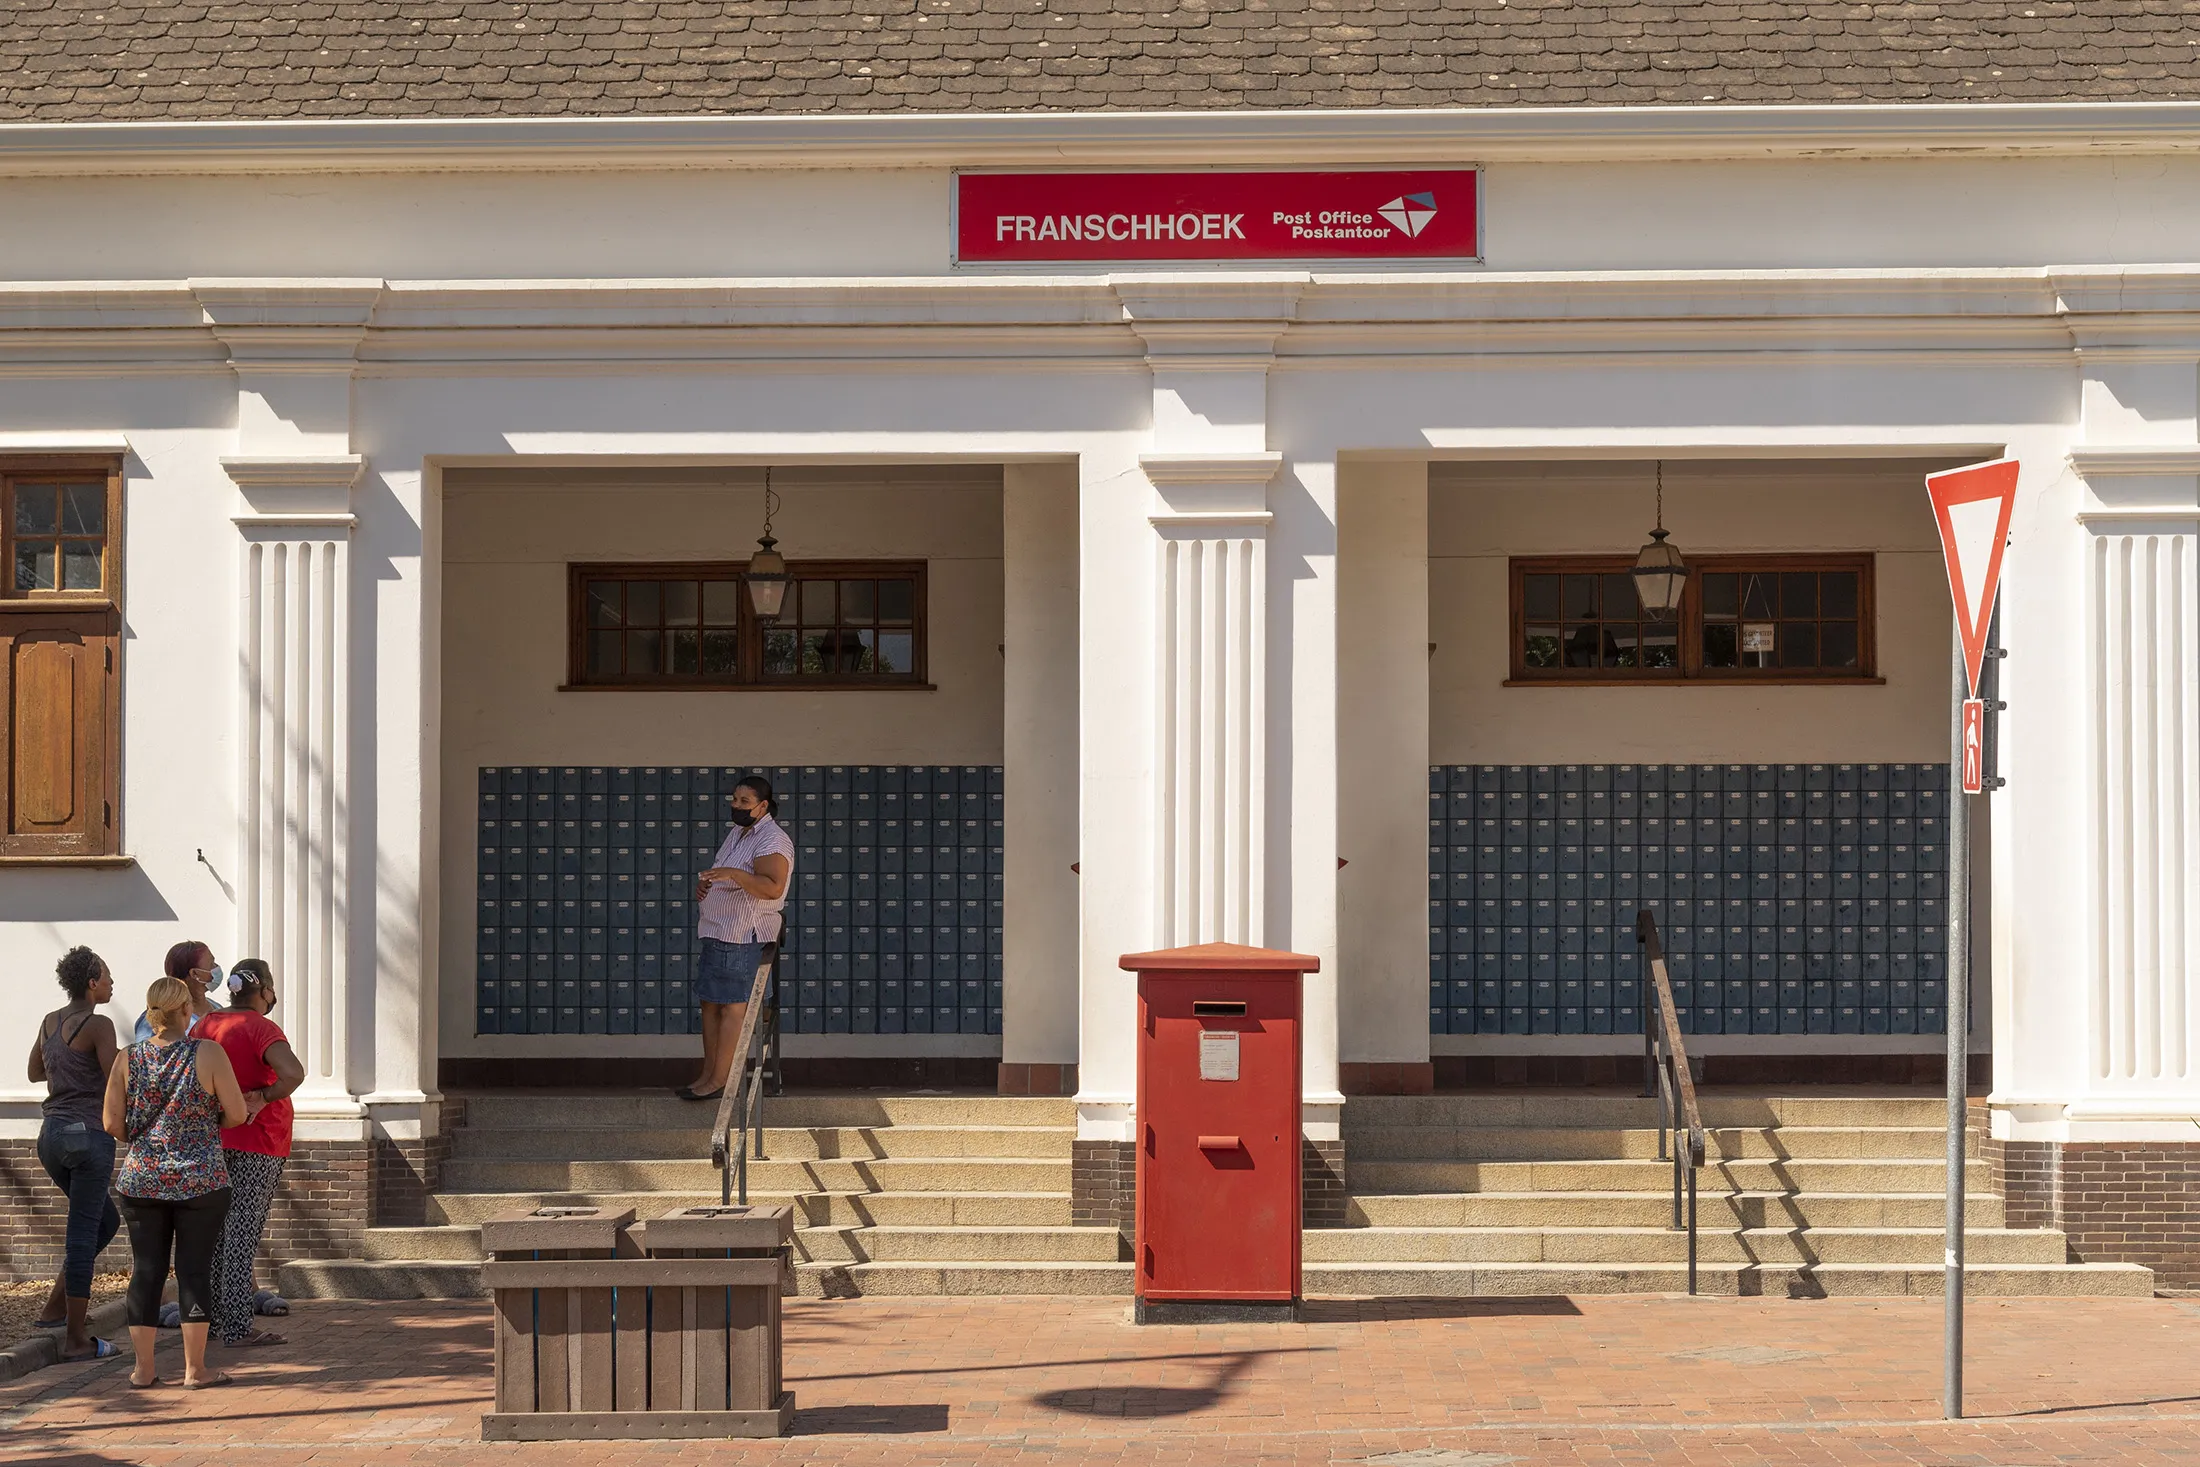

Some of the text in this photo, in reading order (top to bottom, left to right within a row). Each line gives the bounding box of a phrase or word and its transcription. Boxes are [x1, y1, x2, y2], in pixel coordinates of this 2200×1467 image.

[1273, 211, 1373, 225] Post Office
[996, 213, 1246, 241] FRANSCHHOEK
[1292, 225, 1391, 239] Poskantoor
